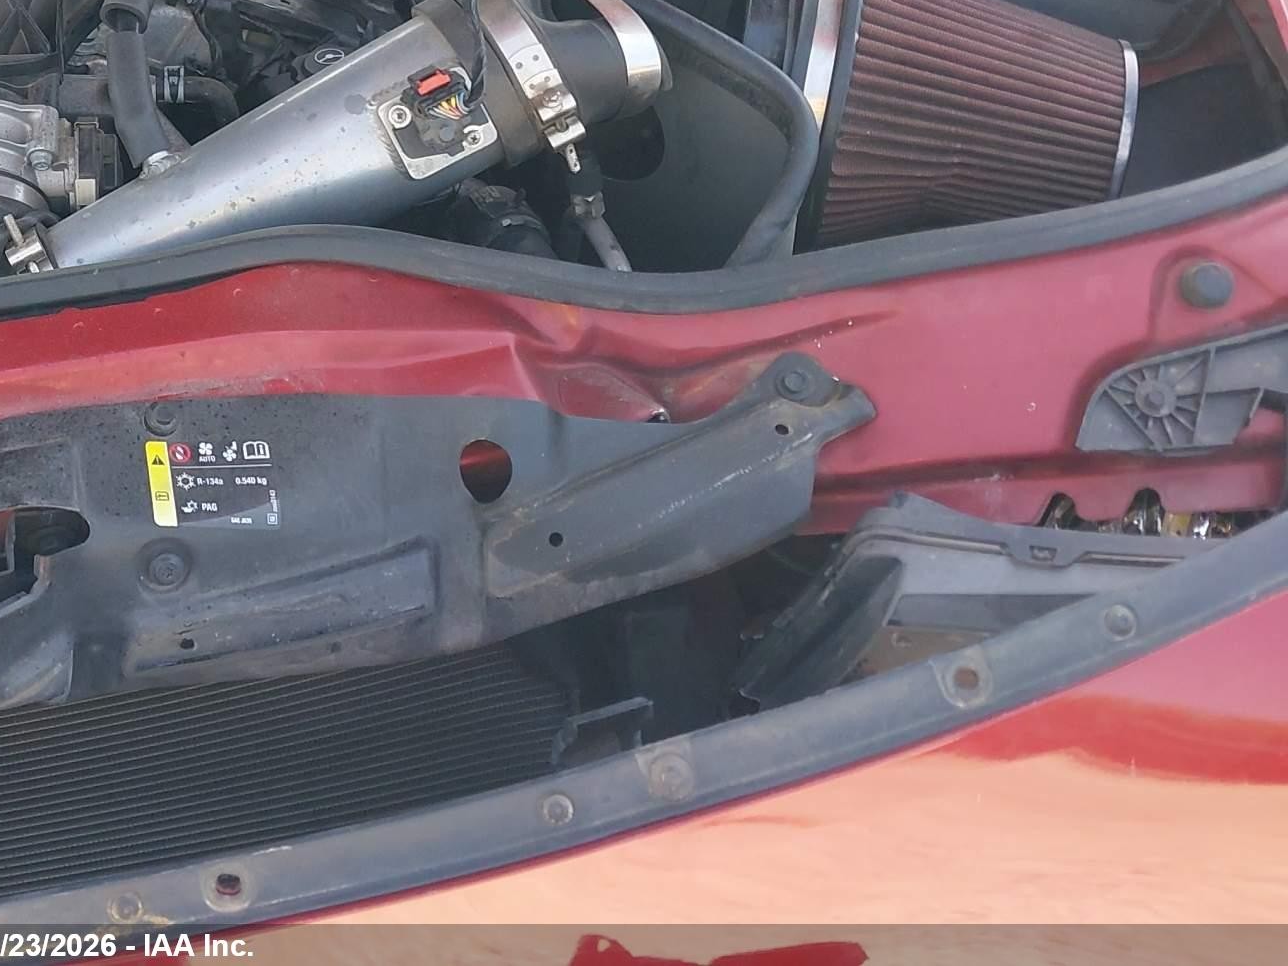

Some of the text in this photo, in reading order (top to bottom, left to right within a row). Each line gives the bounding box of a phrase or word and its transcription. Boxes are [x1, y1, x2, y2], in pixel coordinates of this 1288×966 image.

[196, 476, 268, 486] R-134a 0.540 kg
[201, 502, 218, 512] PAG
